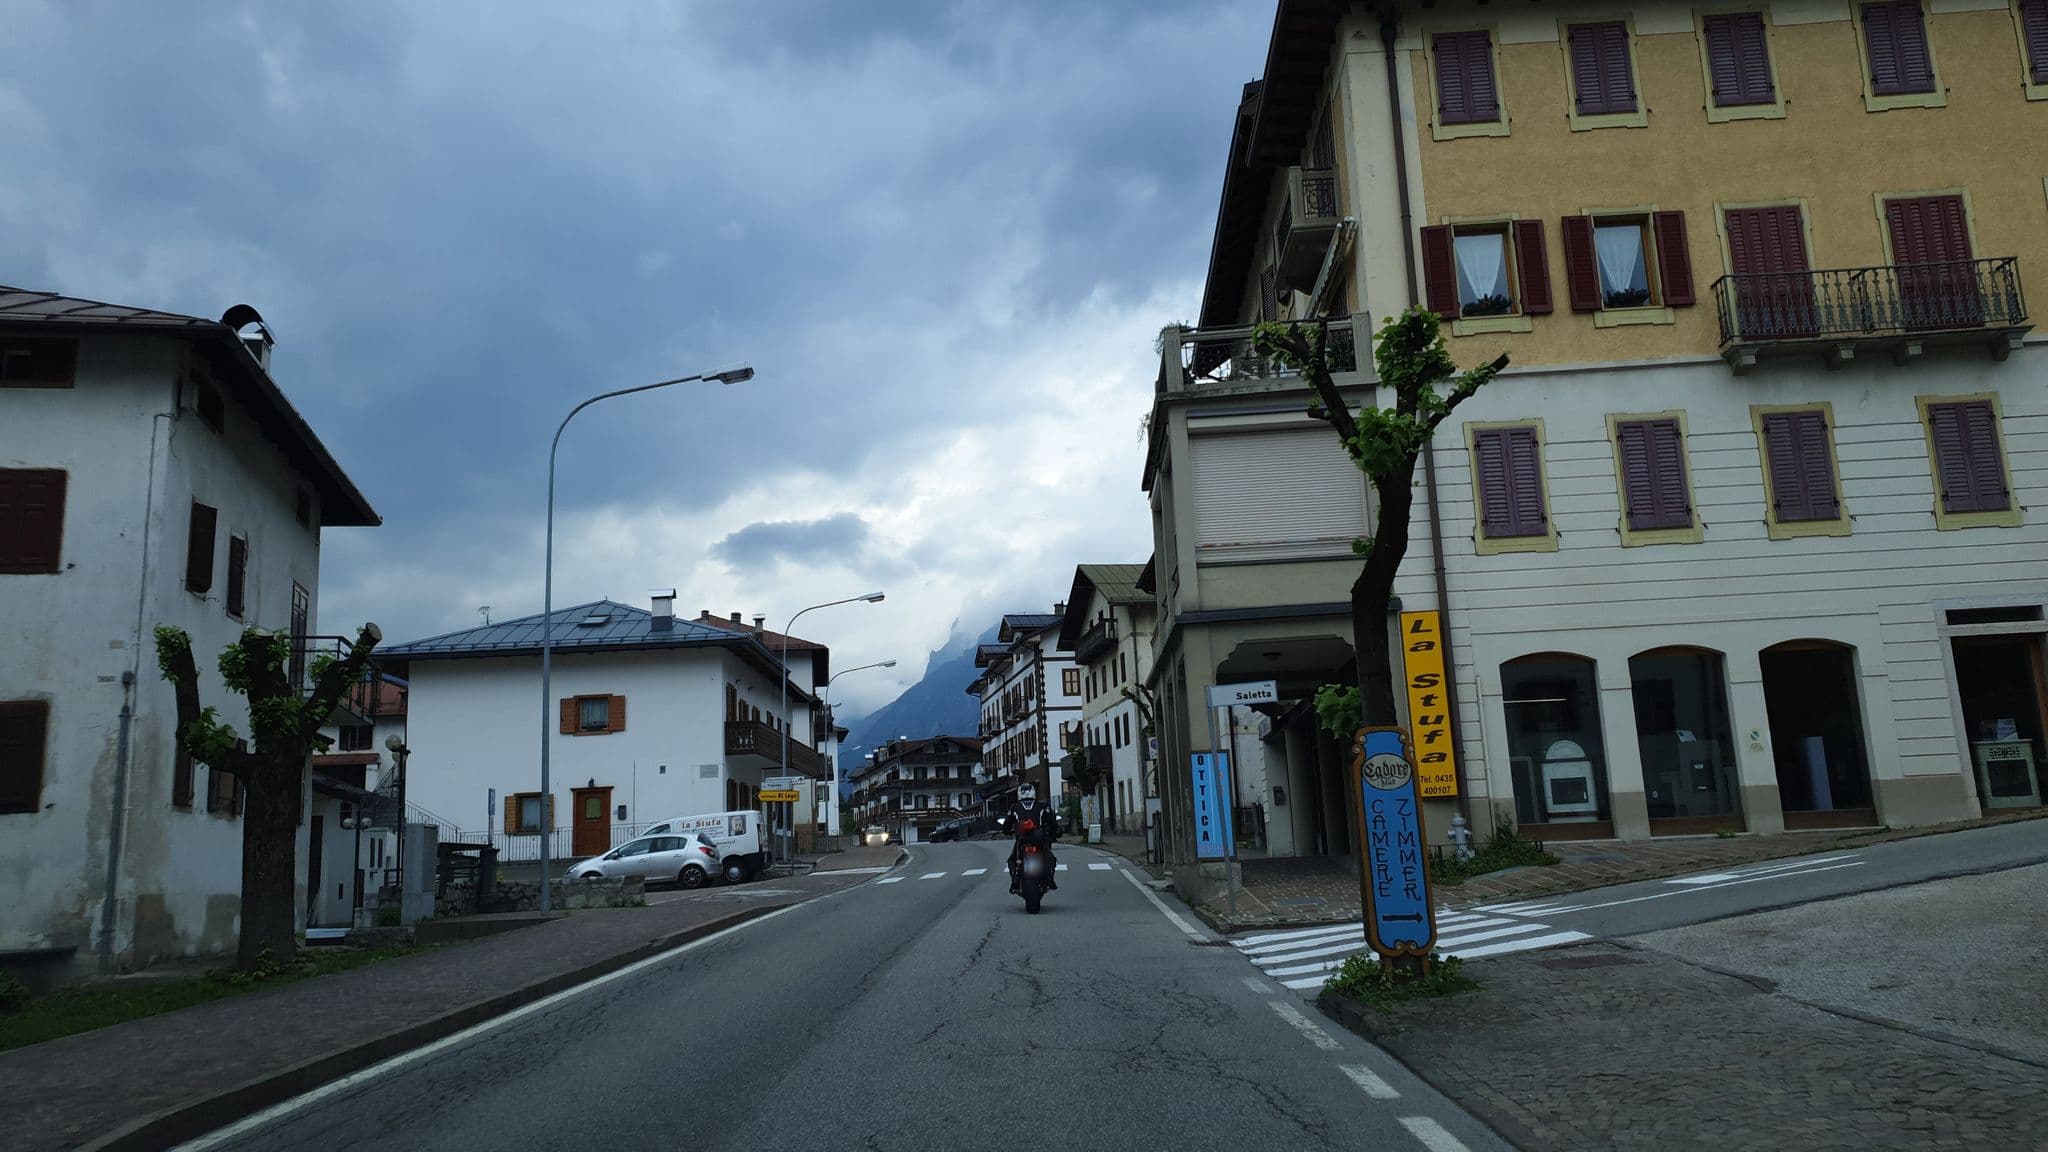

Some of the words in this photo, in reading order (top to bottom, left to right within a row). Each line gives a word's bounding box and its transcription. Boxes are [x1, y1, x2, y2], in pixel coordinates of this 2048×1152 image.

[1410, 619, 1435, 652] La
[1236, 691, 1272, 700] Saletta
[1412, 673, 1447, 763] Stufa
[1197, 755, 1209, 841] OTTICA
[1420, 776, 1433, 784] Tel.
[1435, 774, 1454, 783] 0435
[1423, 785, 1451, 795] 400107
[1372, 800, 1392, 897] CAMERE
[1397, 799, 1421, 901] ZIMMER
